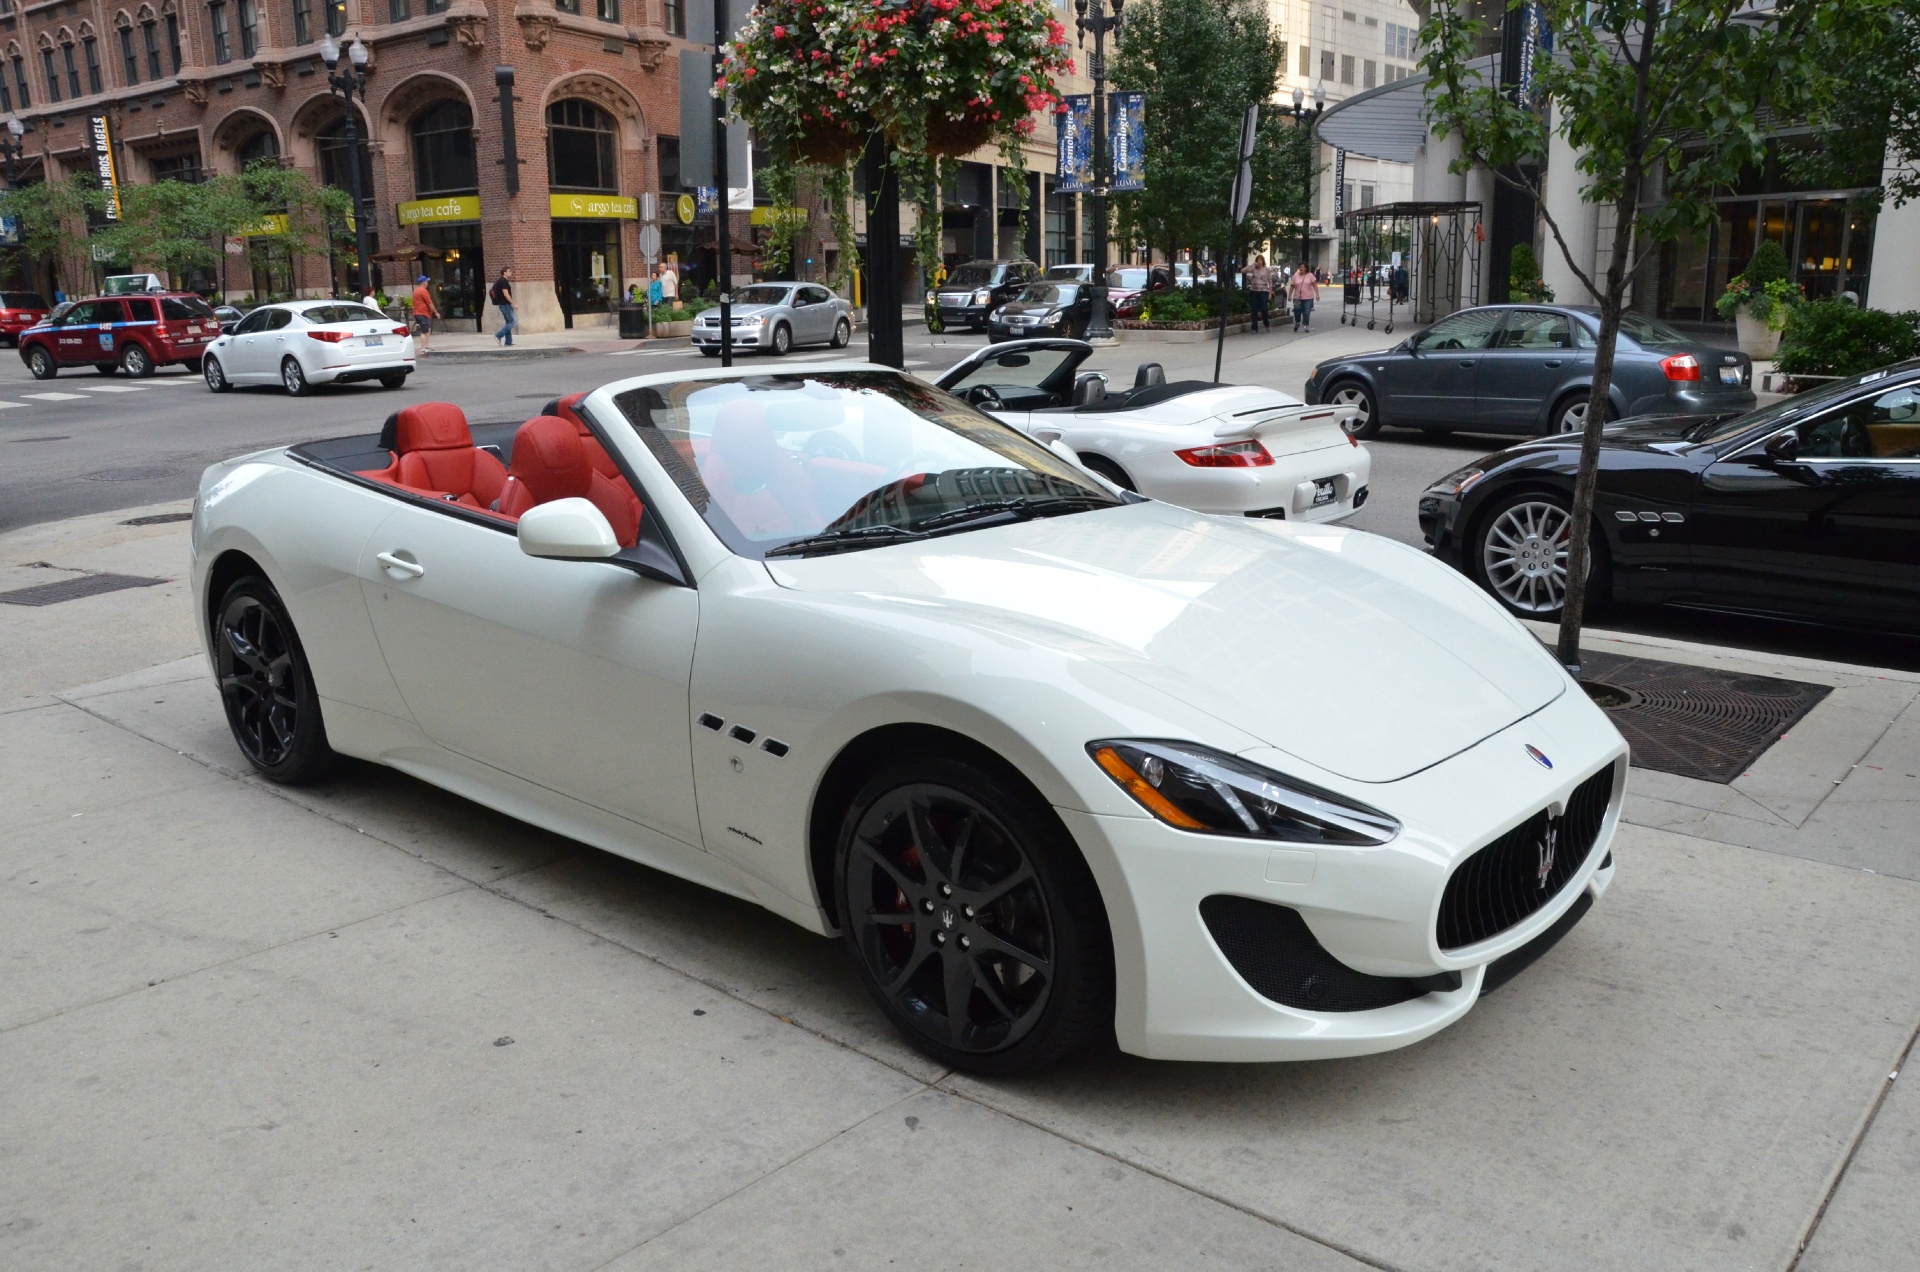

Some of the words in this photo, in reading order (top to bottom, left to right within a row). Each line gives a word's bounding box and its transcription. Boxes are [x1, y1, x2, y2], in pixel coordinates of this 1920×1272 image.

[93, 117, 109, 152] BAGELS
[1065, 110, 1076, 173] Cosmologies
[1117, 107, 1129, 171] Cosmologies
[98, 154, 113, 178] BROS.
[1336, 149, 1344, 194] ORDSTROM
[1115, 179, 1137, 187] LUMA
[420, 205, 434, 217] tea
[436, 199, 462, 216] café
[588, 201, 610, 216] argo
[611, 201, 622, 213] tea
[1335, 196, 1343, 217] rack
